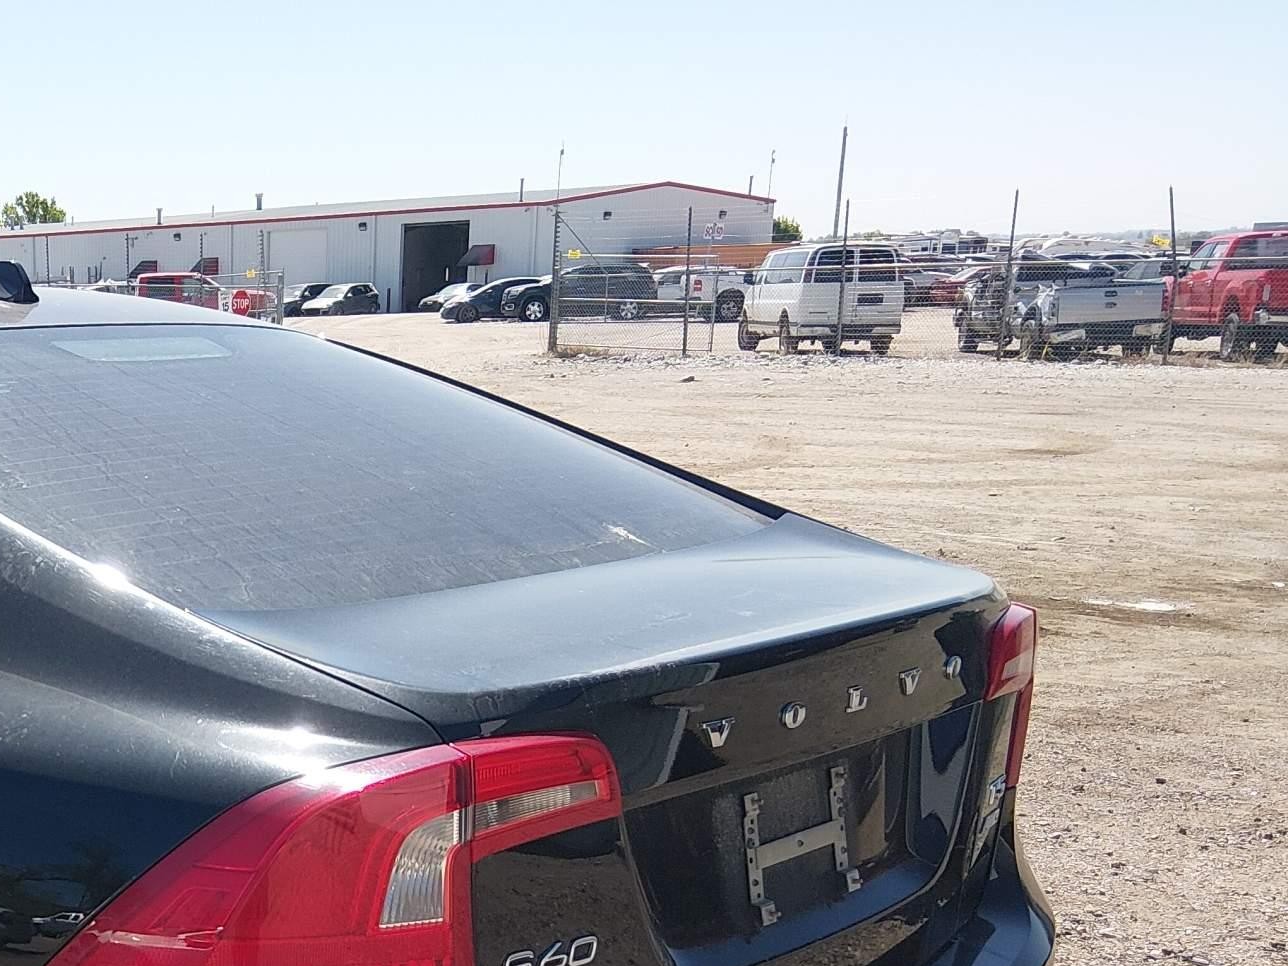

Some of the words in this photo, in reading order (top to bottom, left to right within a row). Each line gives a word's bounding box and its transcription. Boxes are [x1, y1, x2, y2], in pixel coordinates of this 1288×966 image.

[221, 301, 230, 312] 15
[232, 298, 250, 309] STOP
[701, 655, 962, 748] VOLVO
